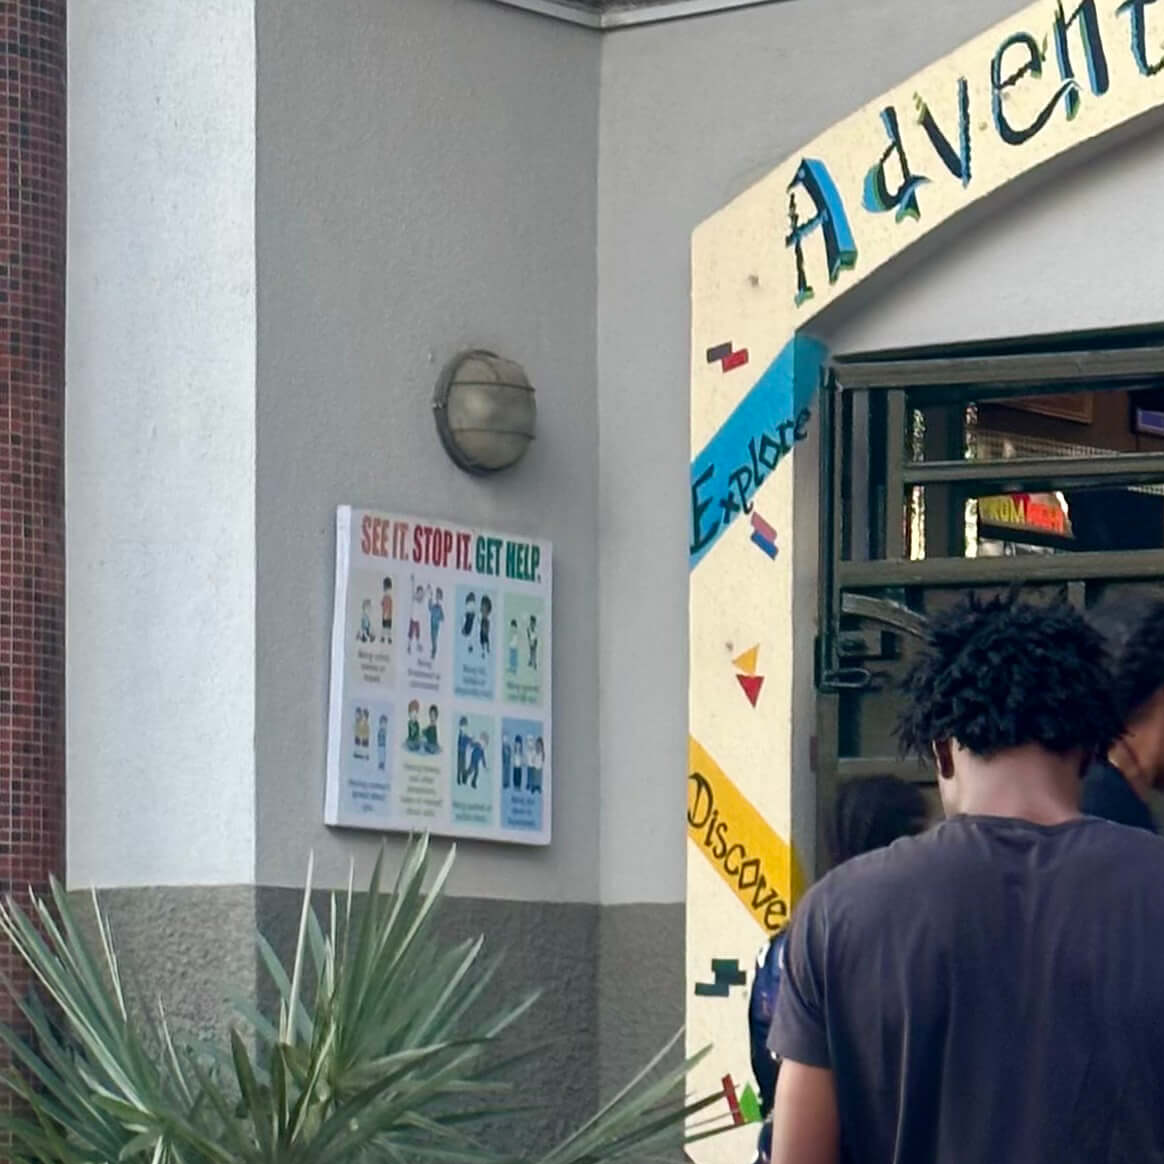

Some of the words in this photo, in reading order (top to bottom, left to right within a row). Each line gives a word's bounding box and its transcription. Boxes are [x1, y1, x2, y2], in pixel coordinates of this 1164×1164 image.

[361, 514, 390, 558] SEE
[392, 521, 409, 561] IT.
[412, 524, 453, 568] STOP
[456, 532, 472, 571] IT.
[475, 535, 503, 577] GET
[505, 541, 542, 584] HELP.
[690, 408, 811, 555] Explore
[687, 772, 787, 931] Discove
